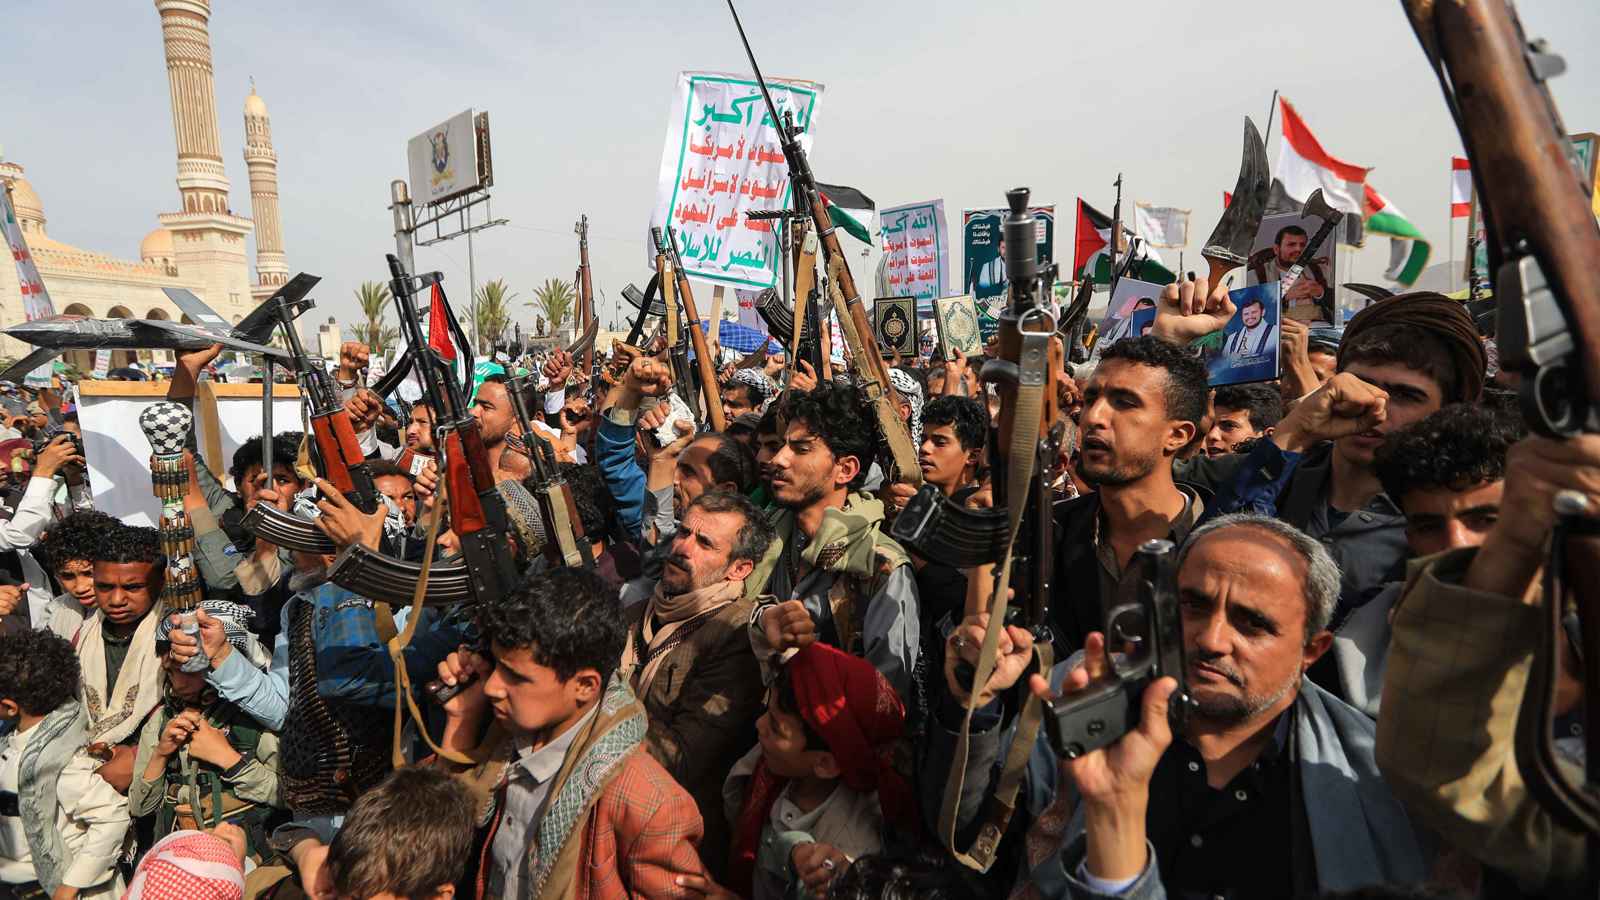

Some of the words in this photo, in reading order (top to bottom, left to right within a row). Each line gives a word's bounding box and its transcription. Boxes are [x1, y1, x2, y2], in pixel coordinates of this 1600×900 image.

[692, 87, 763, 130] أكبر
[761, 97, 804, 127] اله
[689, 132, 745, 161] لأمريكا
[748, 143, 785, 166] موت
[681, 168, 739, 199] لإسرائيل
[740, 178, 786, 201] الموت
[675, 201, 716, 226] اليهود
[716, 207, 738, 231] على
[680, 229, 722, 268] للإسلا
